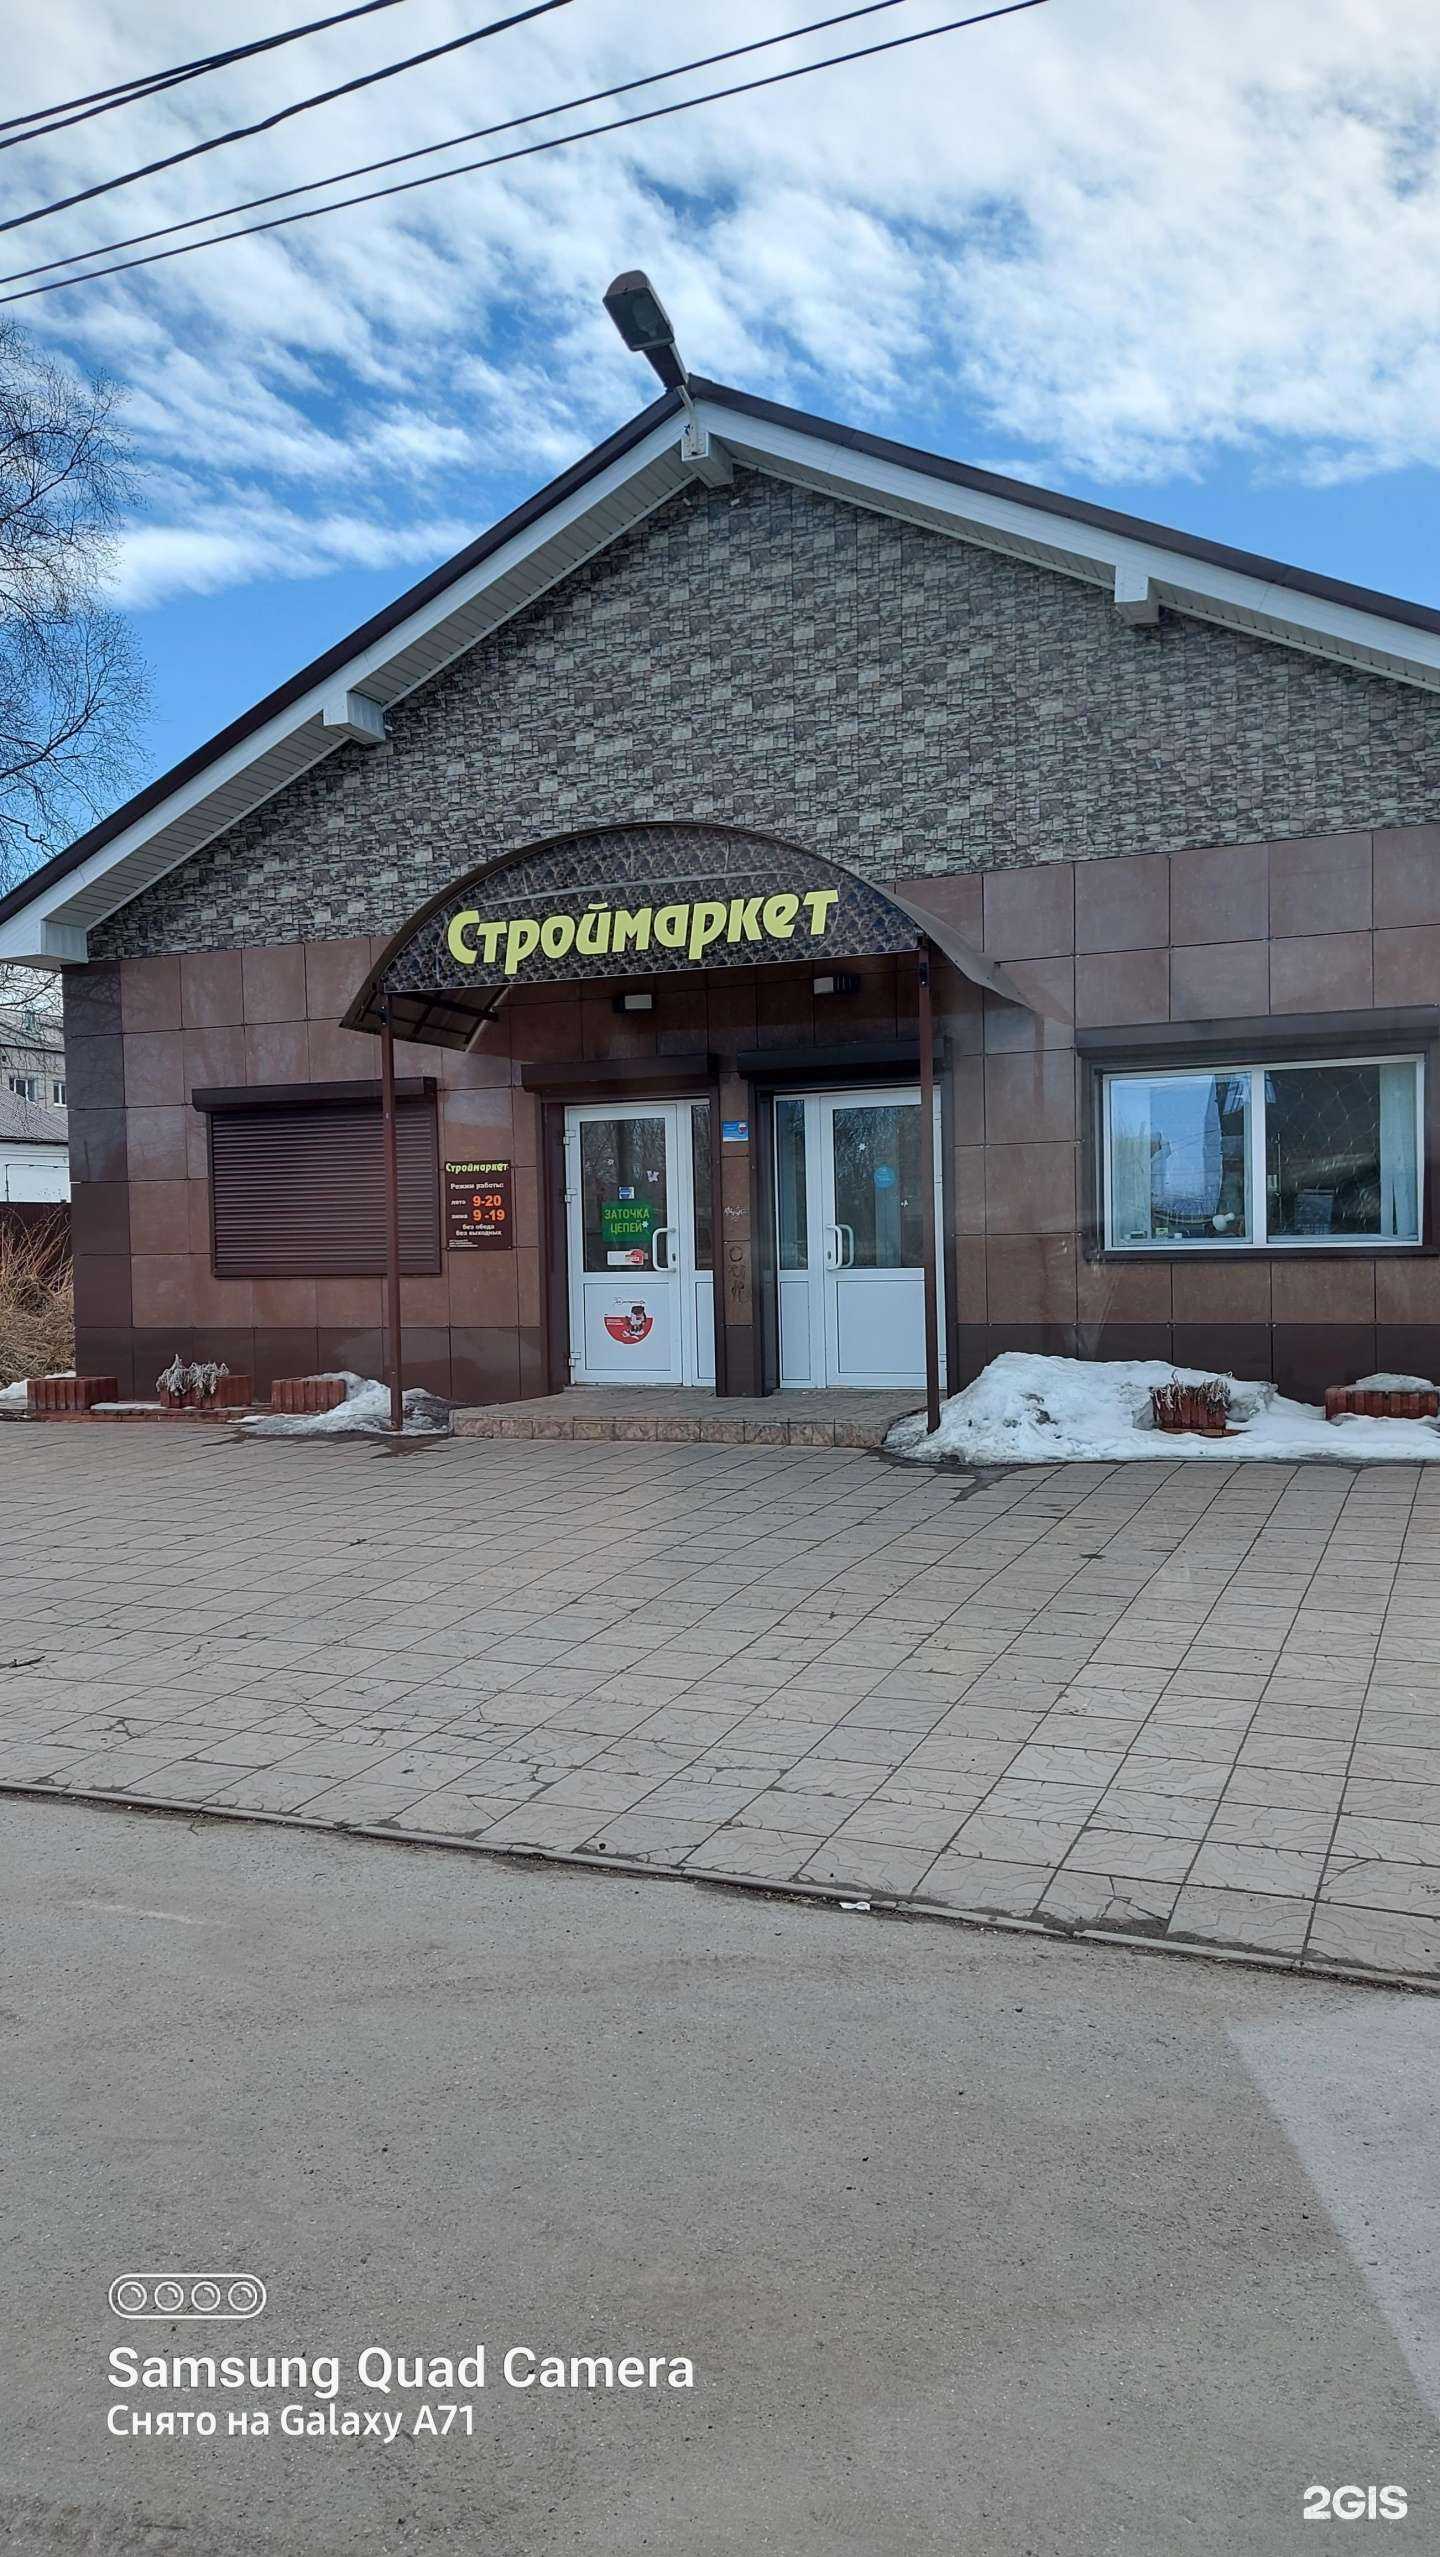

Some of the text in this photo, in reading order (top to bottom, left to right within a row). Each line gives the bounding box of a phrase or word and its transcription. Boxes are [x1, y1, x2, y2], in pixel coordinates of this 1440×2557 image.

[447, 889, 839, 974] Строймаркет
[446, 1163, 508, 1174] Строймаркет
[472, 1195, 502, 1207] 9-20
[604, 1208, 650, 1219] ЗАТОЧКА
[611, 1220, 643, 1234] ЦЕПЕЙ
